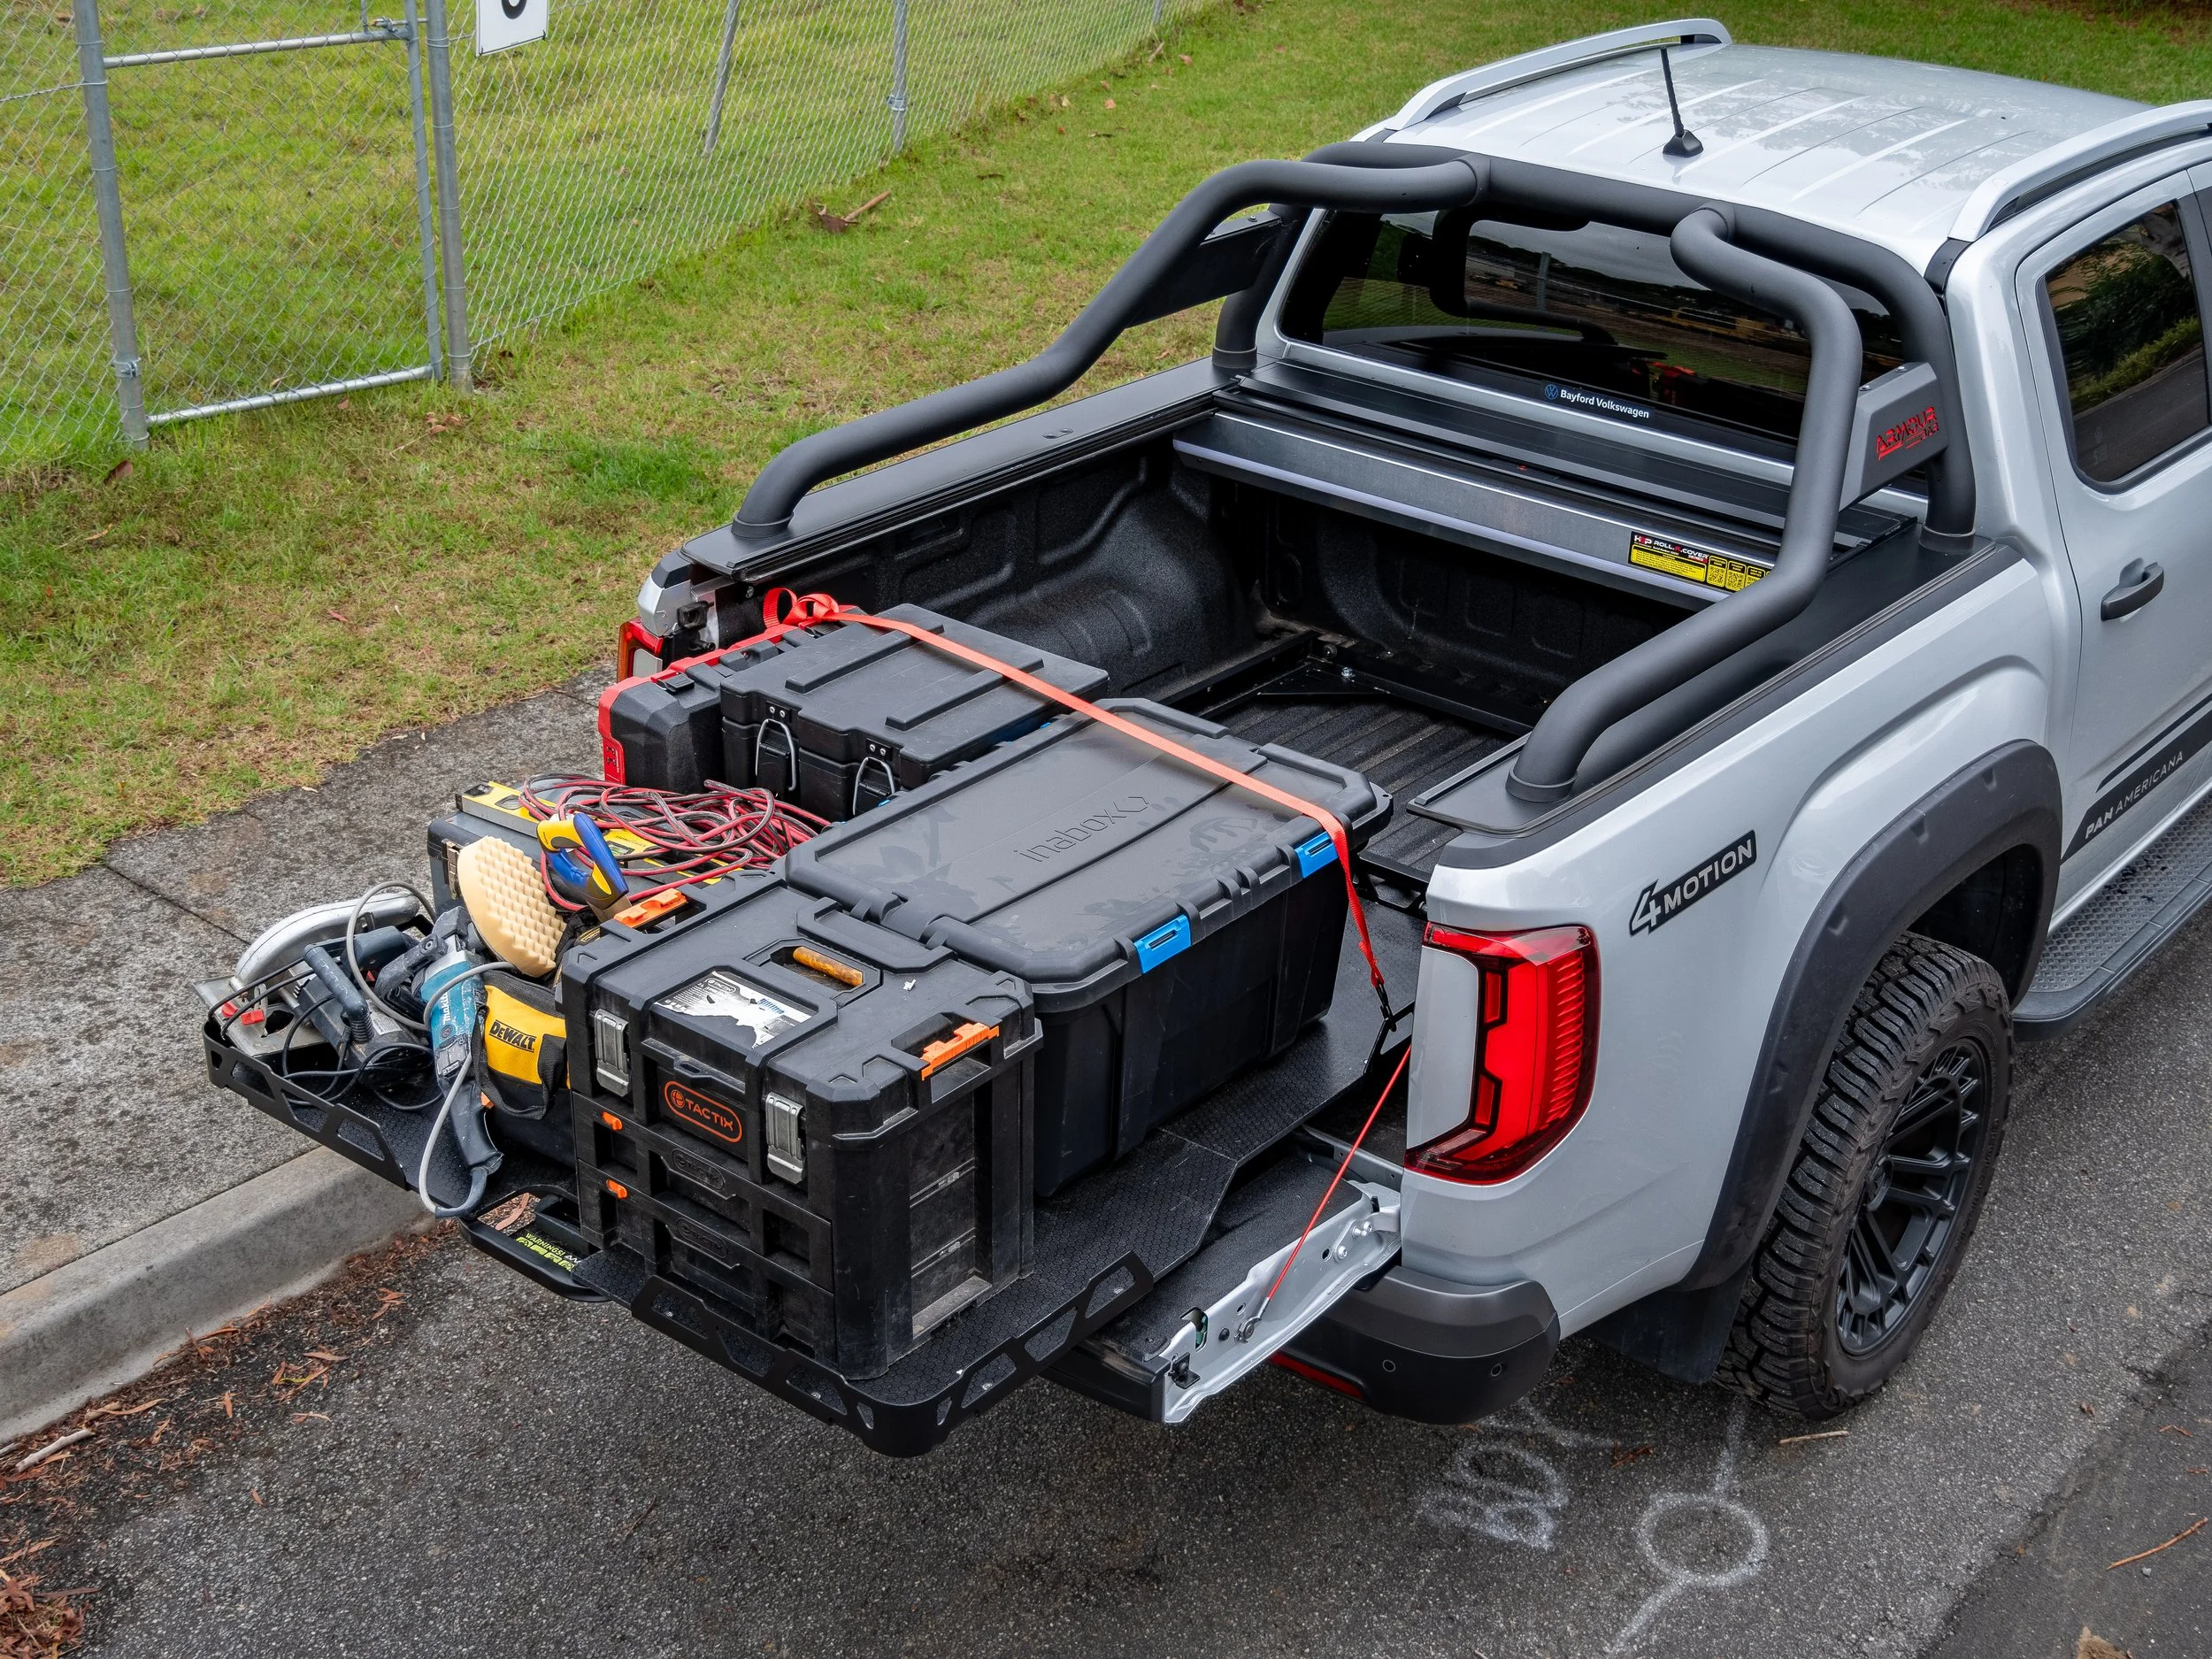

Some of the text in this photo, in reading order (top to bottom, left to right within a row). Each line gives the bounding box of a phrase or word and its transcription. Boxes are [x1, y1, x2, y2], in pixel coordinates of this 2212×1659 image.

[1561, 389, 1649, 419] Bayford Volkswagen
[1877, 406, 1937, 454] ARMOUR
[1014, 810, 1126, 862] inabox
[1632, 839, 1753, 932] 4MOTION
[686, 1098, 733, 1132] TACTIX
[526, 1233, 566, 1256] WARNINGS!
